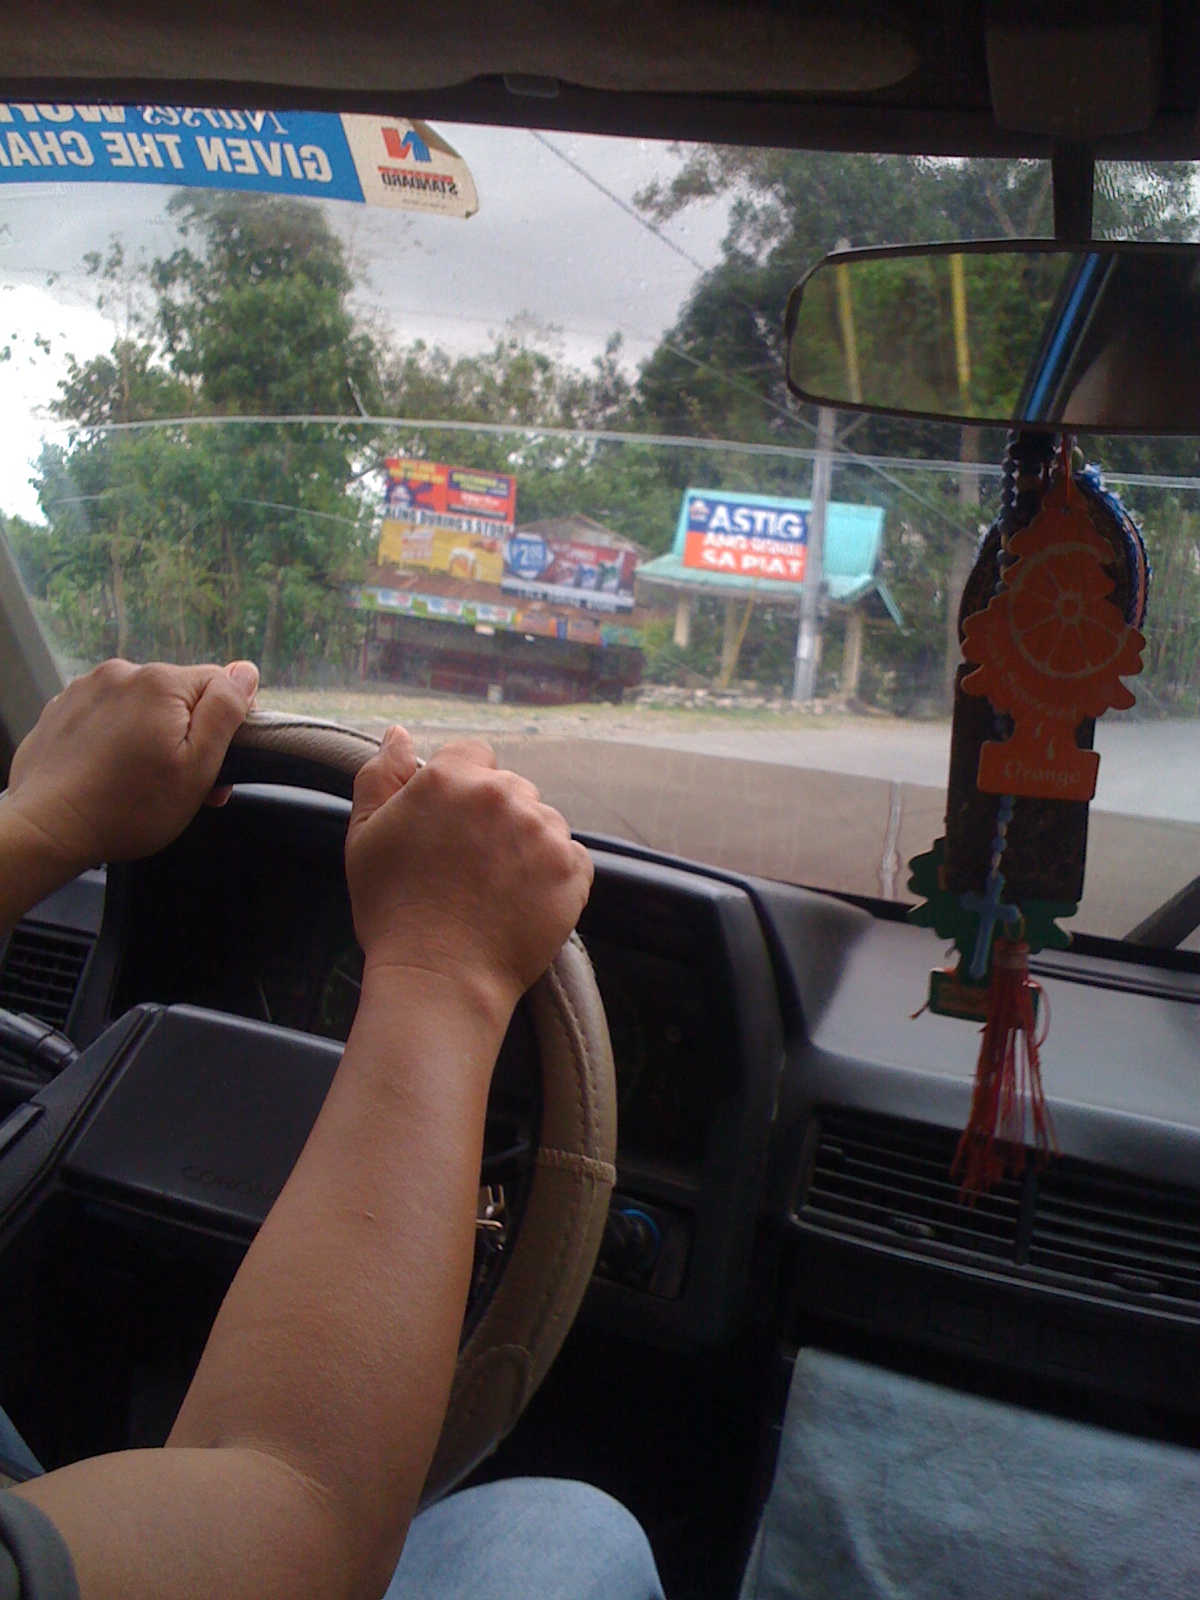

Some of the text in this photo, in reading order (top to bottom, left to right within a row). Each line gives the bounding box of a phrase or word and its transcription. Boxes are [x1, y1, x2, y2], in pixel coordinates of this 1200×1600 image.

[708, 504, 803, 540] ASTIG
[701, 549, 804, 575] SA PIAT
[1004, 759, 1082, 788] Orange
[182, 1166, 277, 1200] CORON
